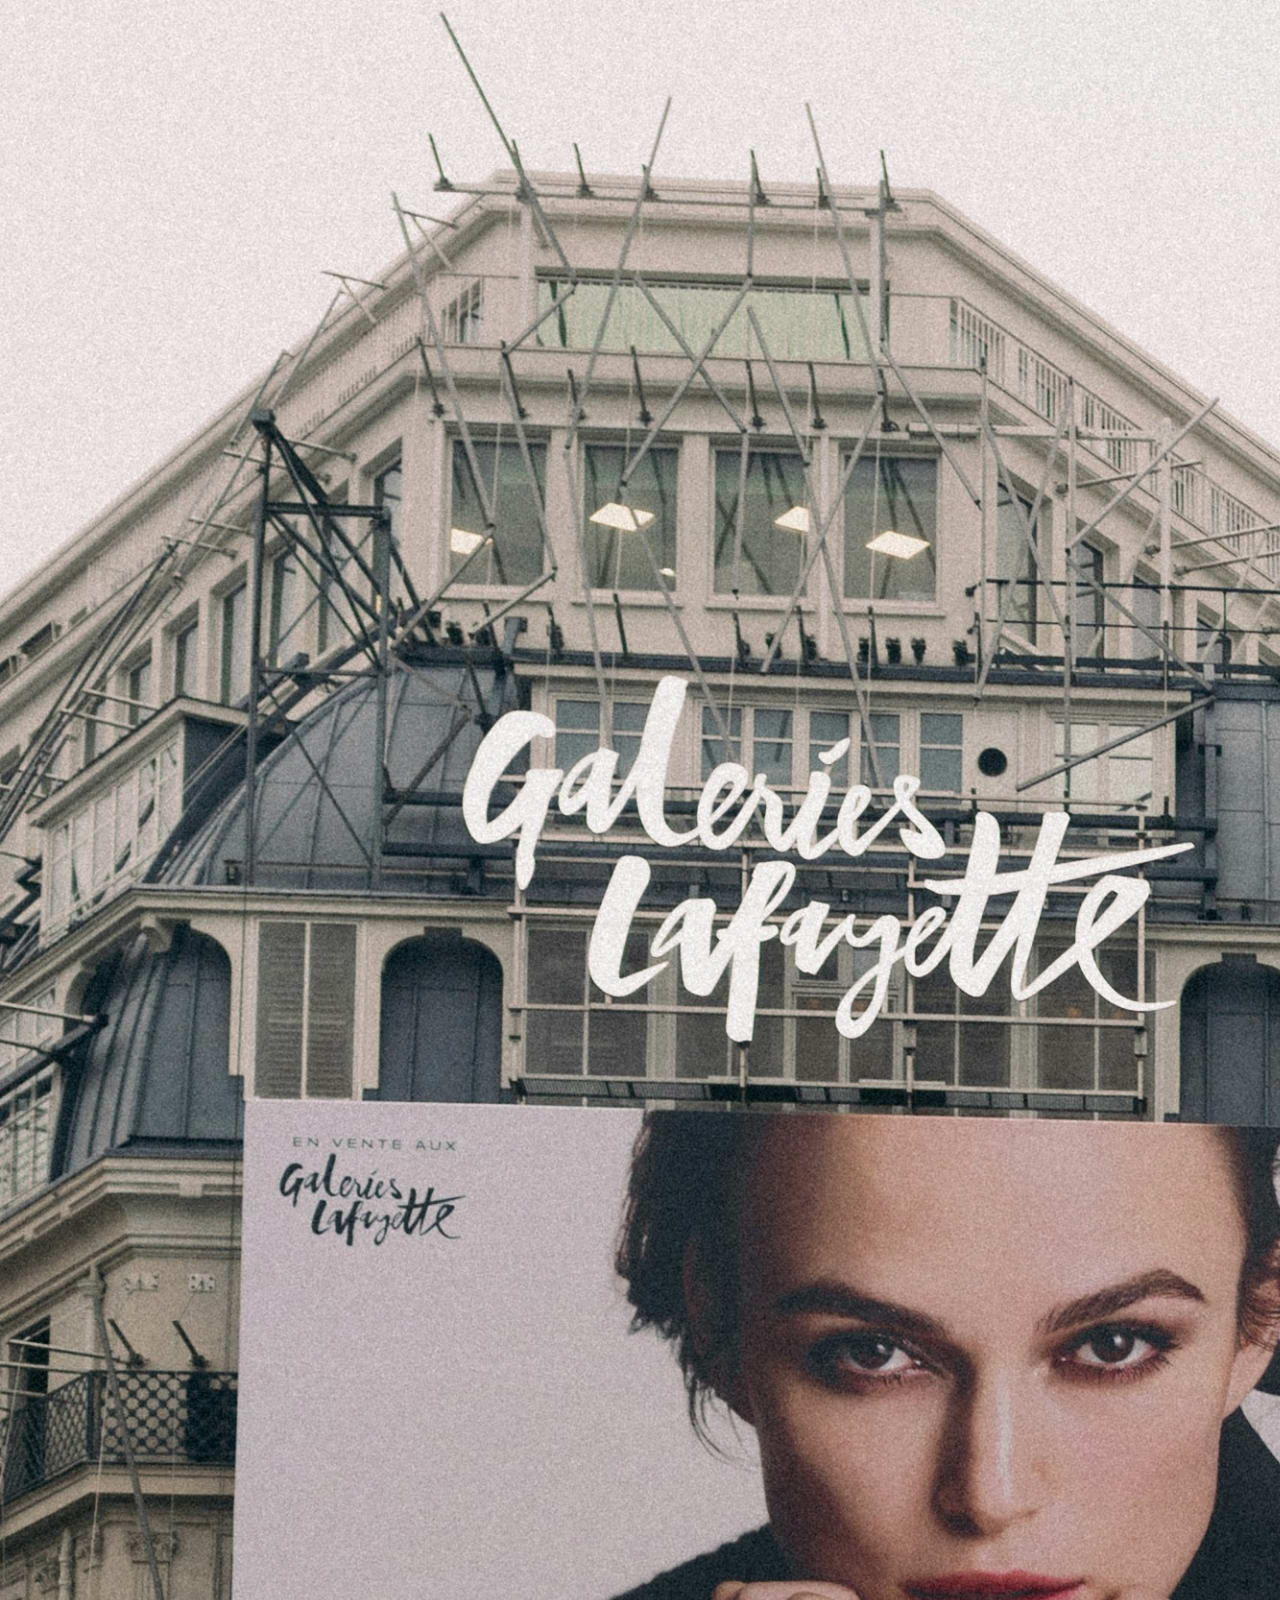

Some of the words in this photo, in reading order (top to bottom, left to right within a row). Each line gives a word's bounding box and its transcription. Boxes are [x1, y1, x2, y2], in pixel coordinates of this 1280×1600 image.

[463, 675, 947, 890] Galeries
[588, 811, 1195, 1043] Lafayette
[292, 1136, 320, 1147] EN
[332, 1137, 402, 1149] VENTE
[415, 1139, 458, 1150] AUX
[279, 1153, 402, 1207] Galeries
[311, 1187, 467, 1246] Lafayette
